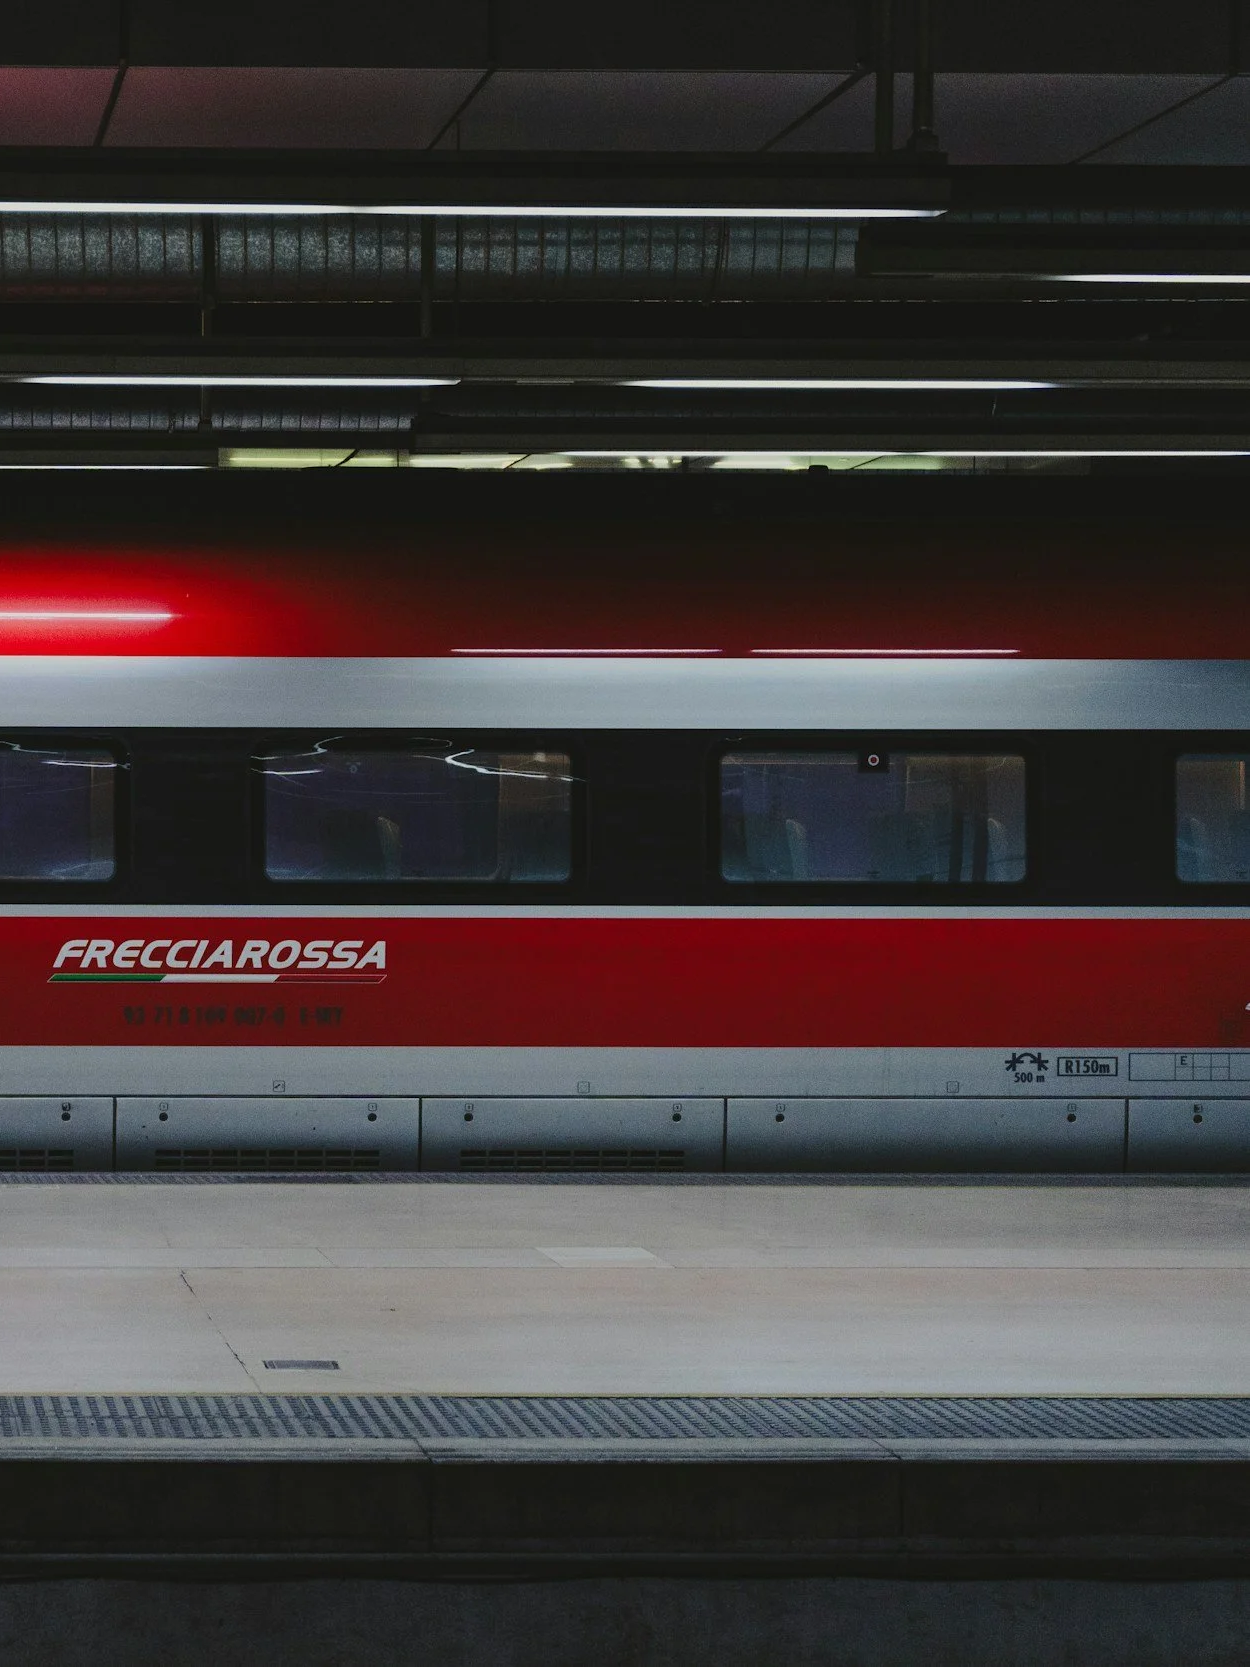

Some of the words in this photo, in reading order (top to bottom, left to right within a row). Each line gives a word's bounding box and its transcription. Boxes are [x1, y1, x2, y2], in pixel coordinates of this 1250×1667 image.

[52, 939, 387, 970] FRECCIAROSSA
[1065, 1060, 1111, 1074] R150m
[1180, 1056, 1188, 1066] E
[1014, 1072, 1033, 1083] 500
[1036, 1075, 1045, 1083] m
